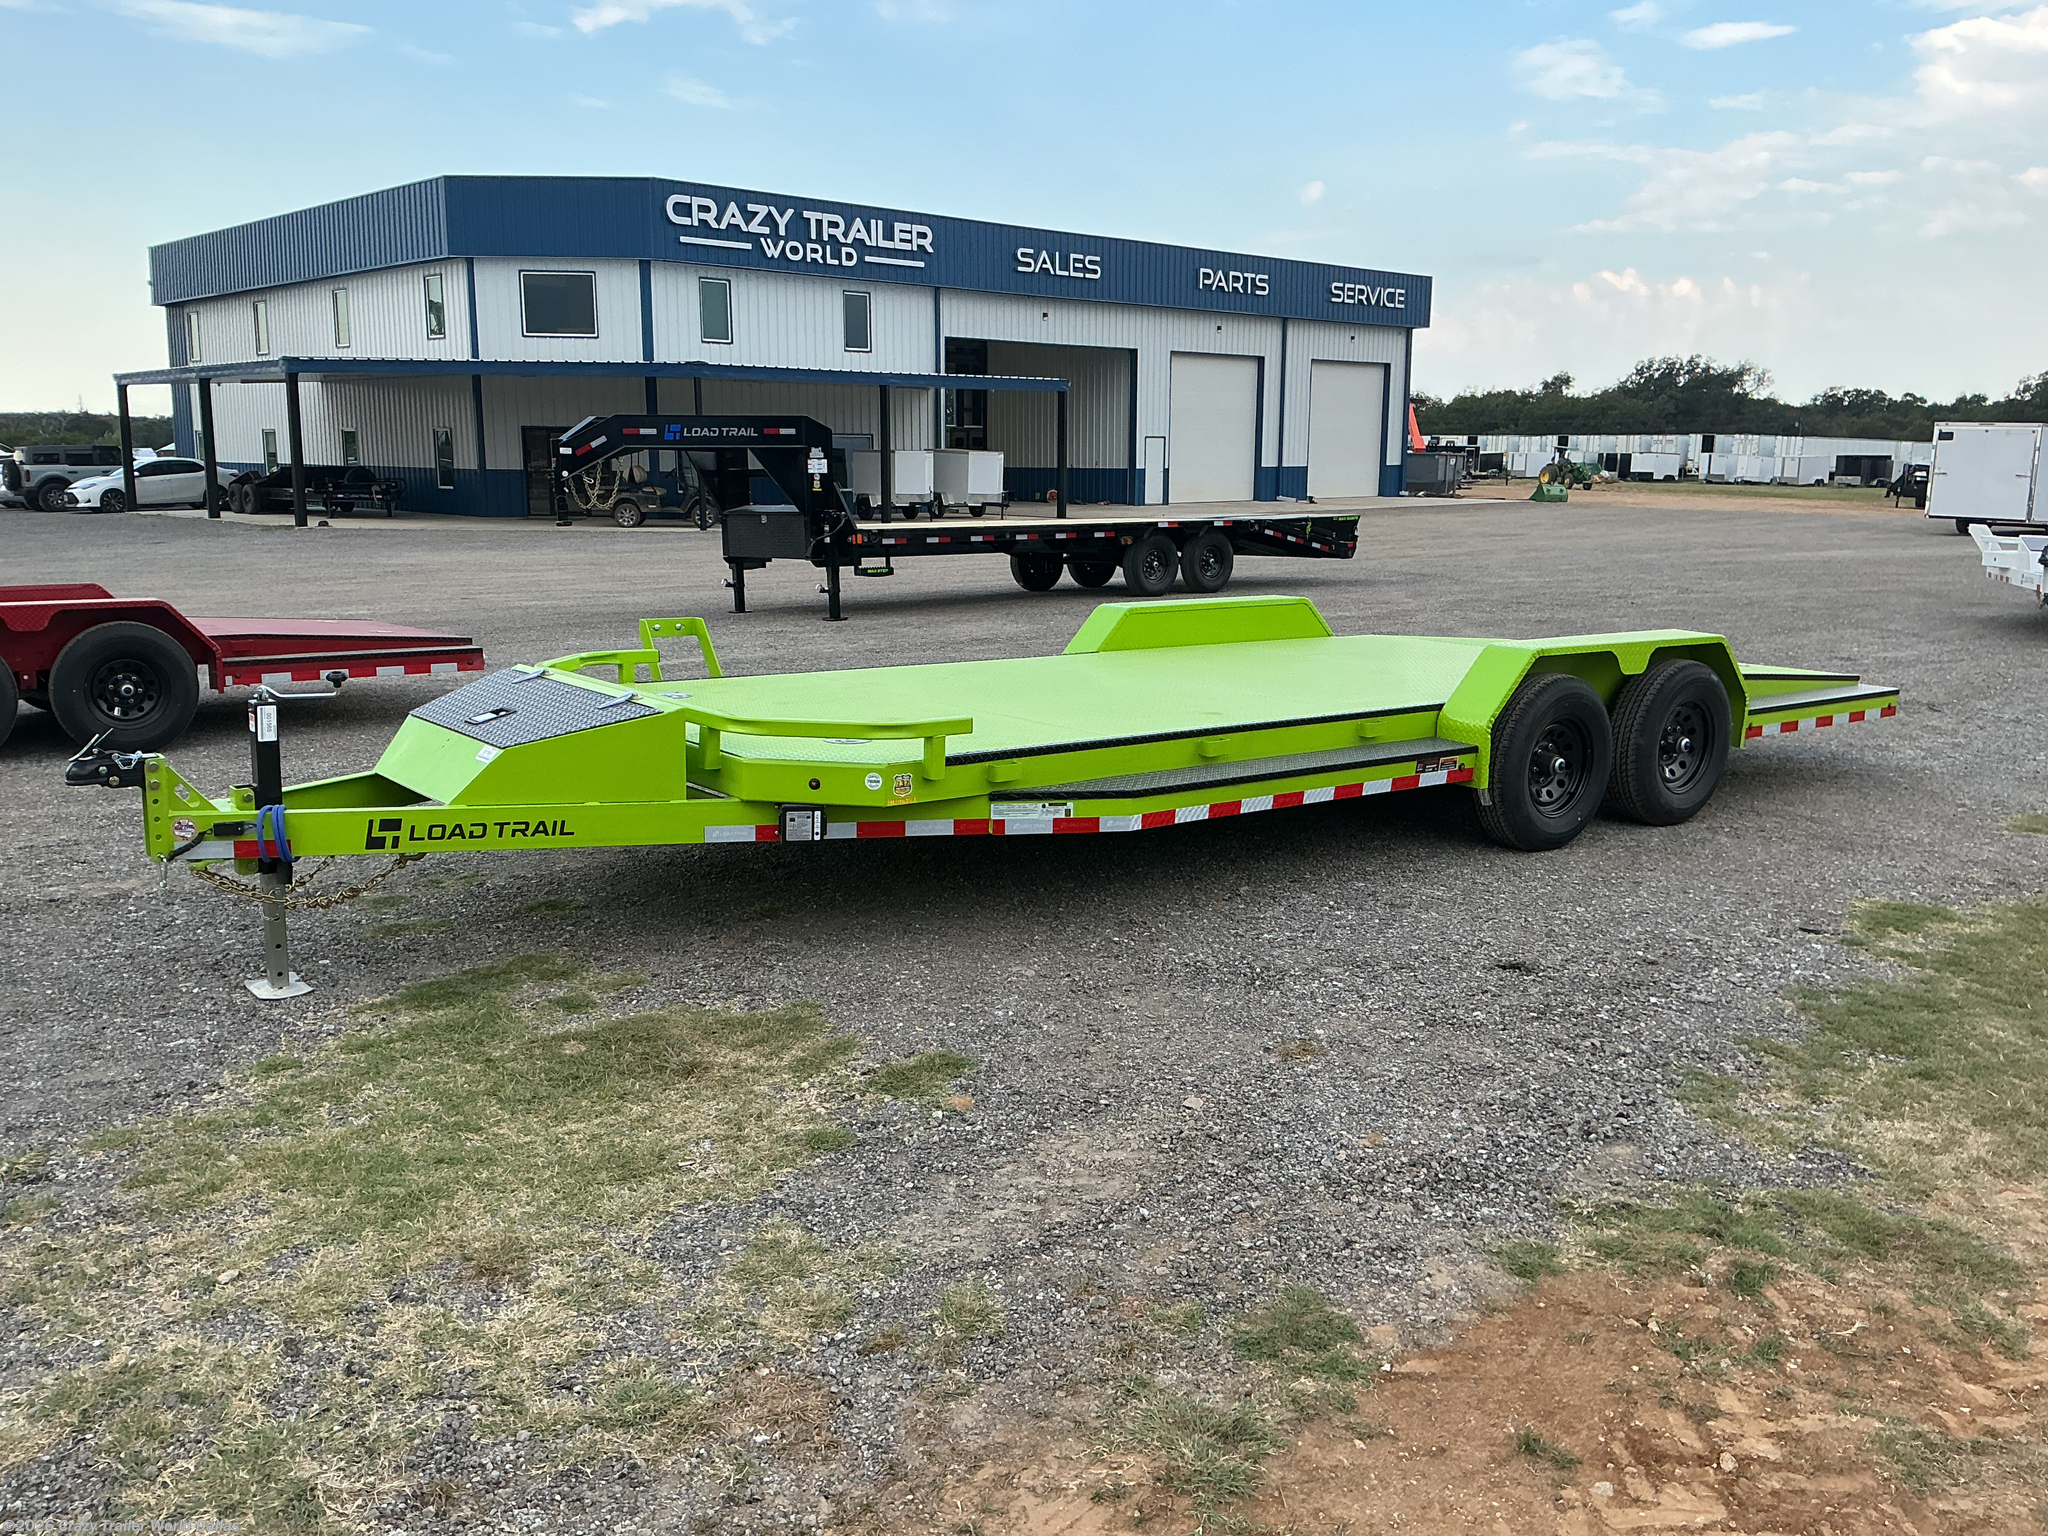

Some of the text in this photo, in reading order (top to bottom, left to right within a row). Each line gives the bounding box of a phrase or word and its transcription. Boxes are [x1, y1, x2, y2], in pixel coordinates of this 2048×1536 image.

[666, 194, 934, 252] CRAZY TRAILER
[760, 237, 858, 267] WORLD
[1016, 247, 1101, 279] SALES
[1198, 267, 1270, 296] PARTS
[1330, 281, 1406, 309] SERVICE
[683, 427, 758, 437] LOAD TRAIL
[409, 820, 575, 841] LOAD TRAIL
